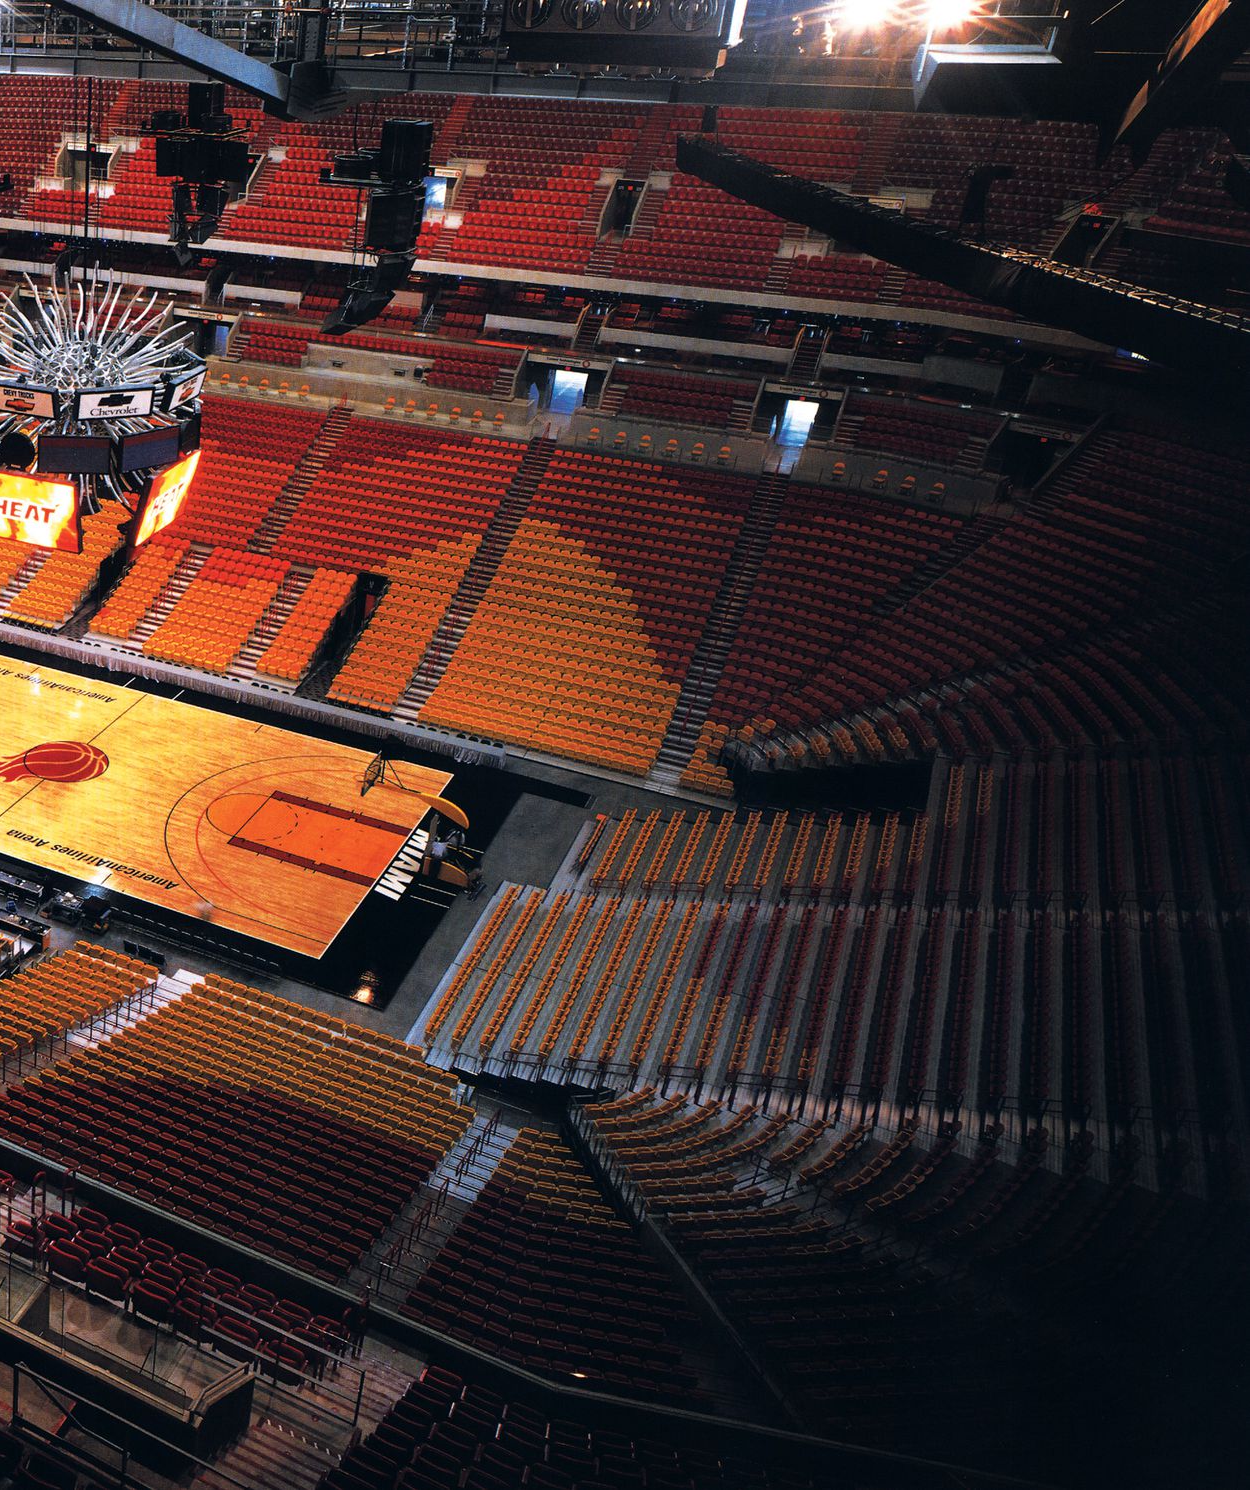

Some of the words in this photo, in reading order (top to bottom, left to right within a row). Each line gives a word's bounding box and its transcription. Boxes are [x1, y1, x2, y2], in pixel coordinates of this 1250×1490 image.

[18, 390, 35, 400] TRUCKS
[90, 406, 140, 417] Chevrolet
[14, 672, 117, 703] AmericanAirlines
[6, 829, 50, 848] Arena
[50, 844, 180, 890] AmericanAirlines
[374, 828, 430, 901] MIAMI
